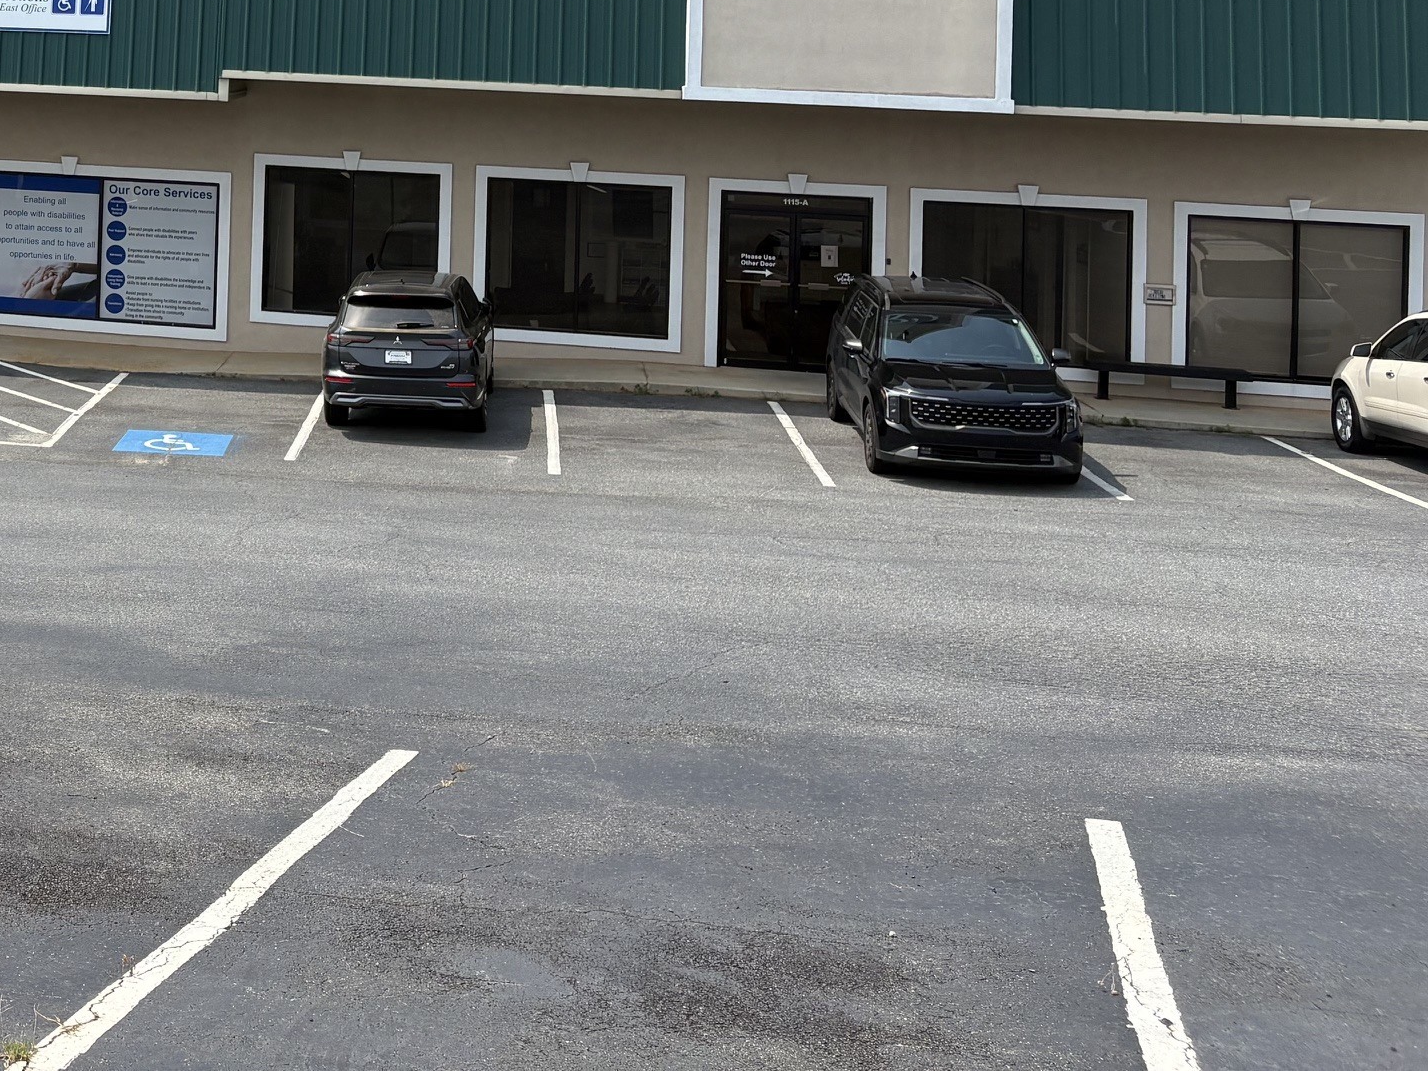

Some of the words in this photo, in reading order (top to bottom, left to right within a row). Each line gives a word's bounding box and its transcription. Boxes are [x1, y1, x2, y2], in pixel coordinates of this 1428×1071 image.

[0, 4, 18, 12] East
[21, 4, 47, 14] Office
[109, 184, 130, 195] Our
[133, 186, 160, 196] Core
[164, 187, 212, 199] Services
[24, 196, 56, 206] Enabling
[47, 211, 86, 220] disabilities
